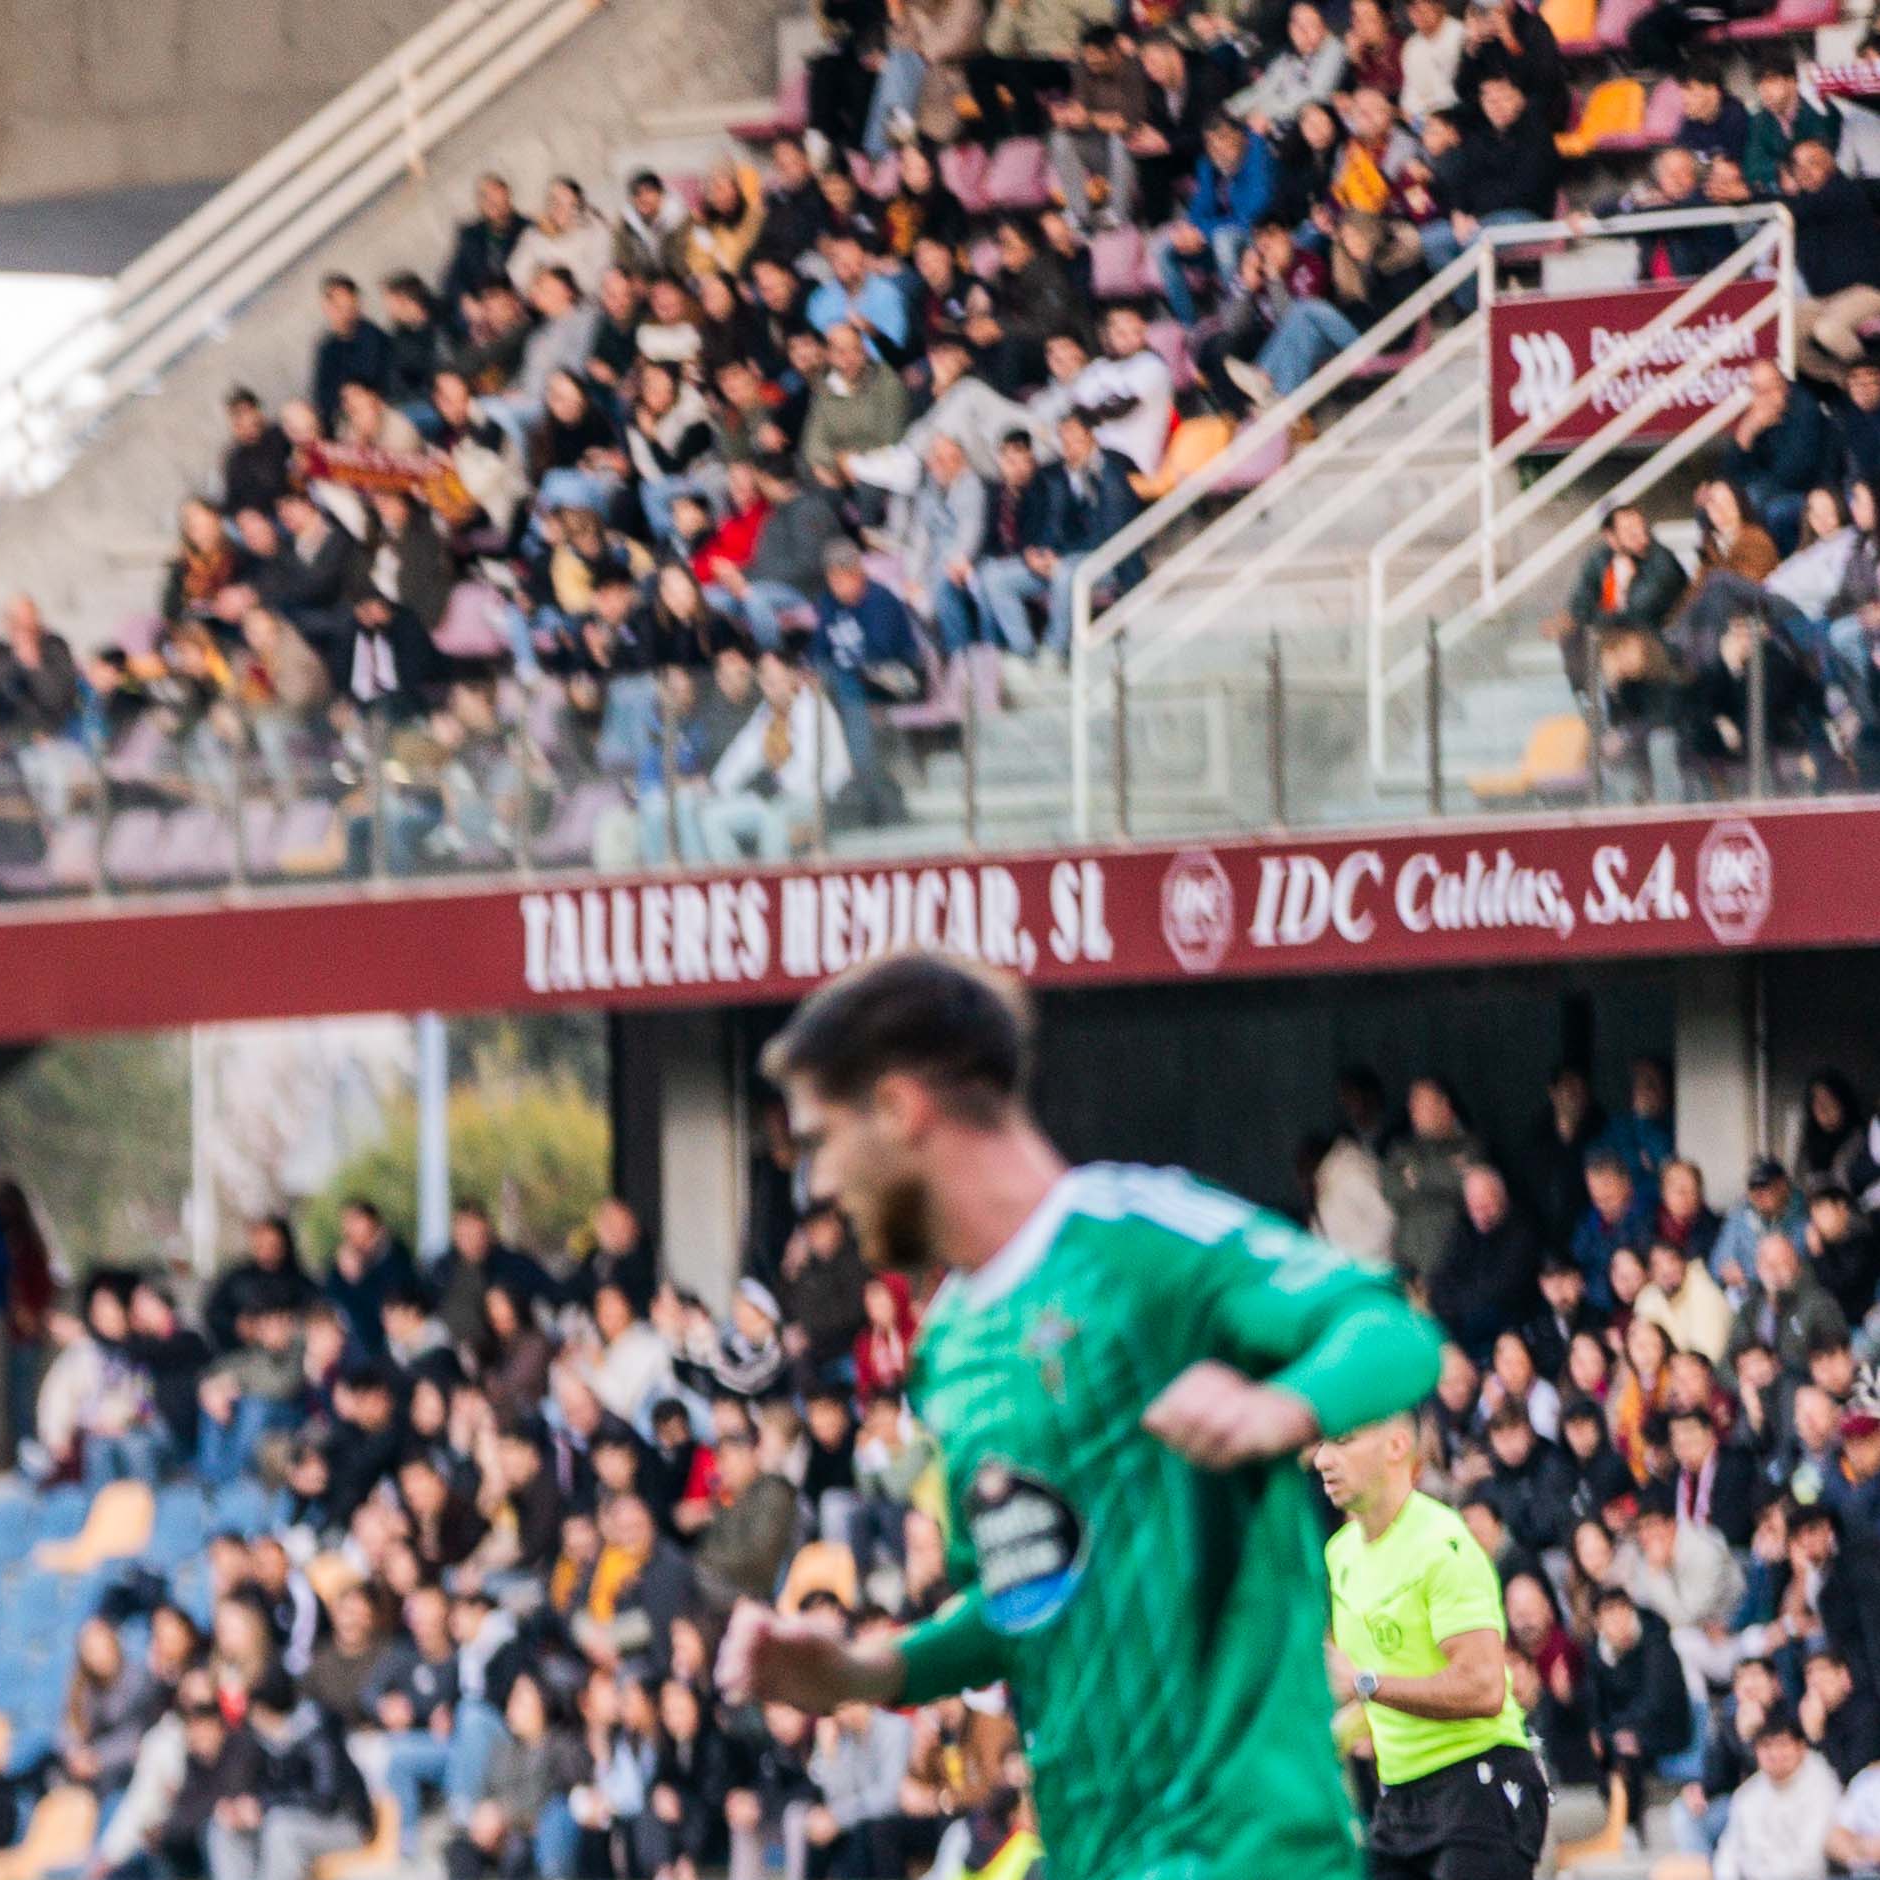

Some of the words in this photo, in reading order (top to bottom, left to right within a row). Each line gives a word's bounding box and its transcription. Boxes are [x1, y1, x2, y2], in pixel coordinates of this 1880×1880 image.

[522, 880, 770, 994] TALLERES
[1248, 850, 1384, 948] IDC
[1394, 846, 1576, 940] Caldas,
[1585, 843, 1691, 925] S.A.
